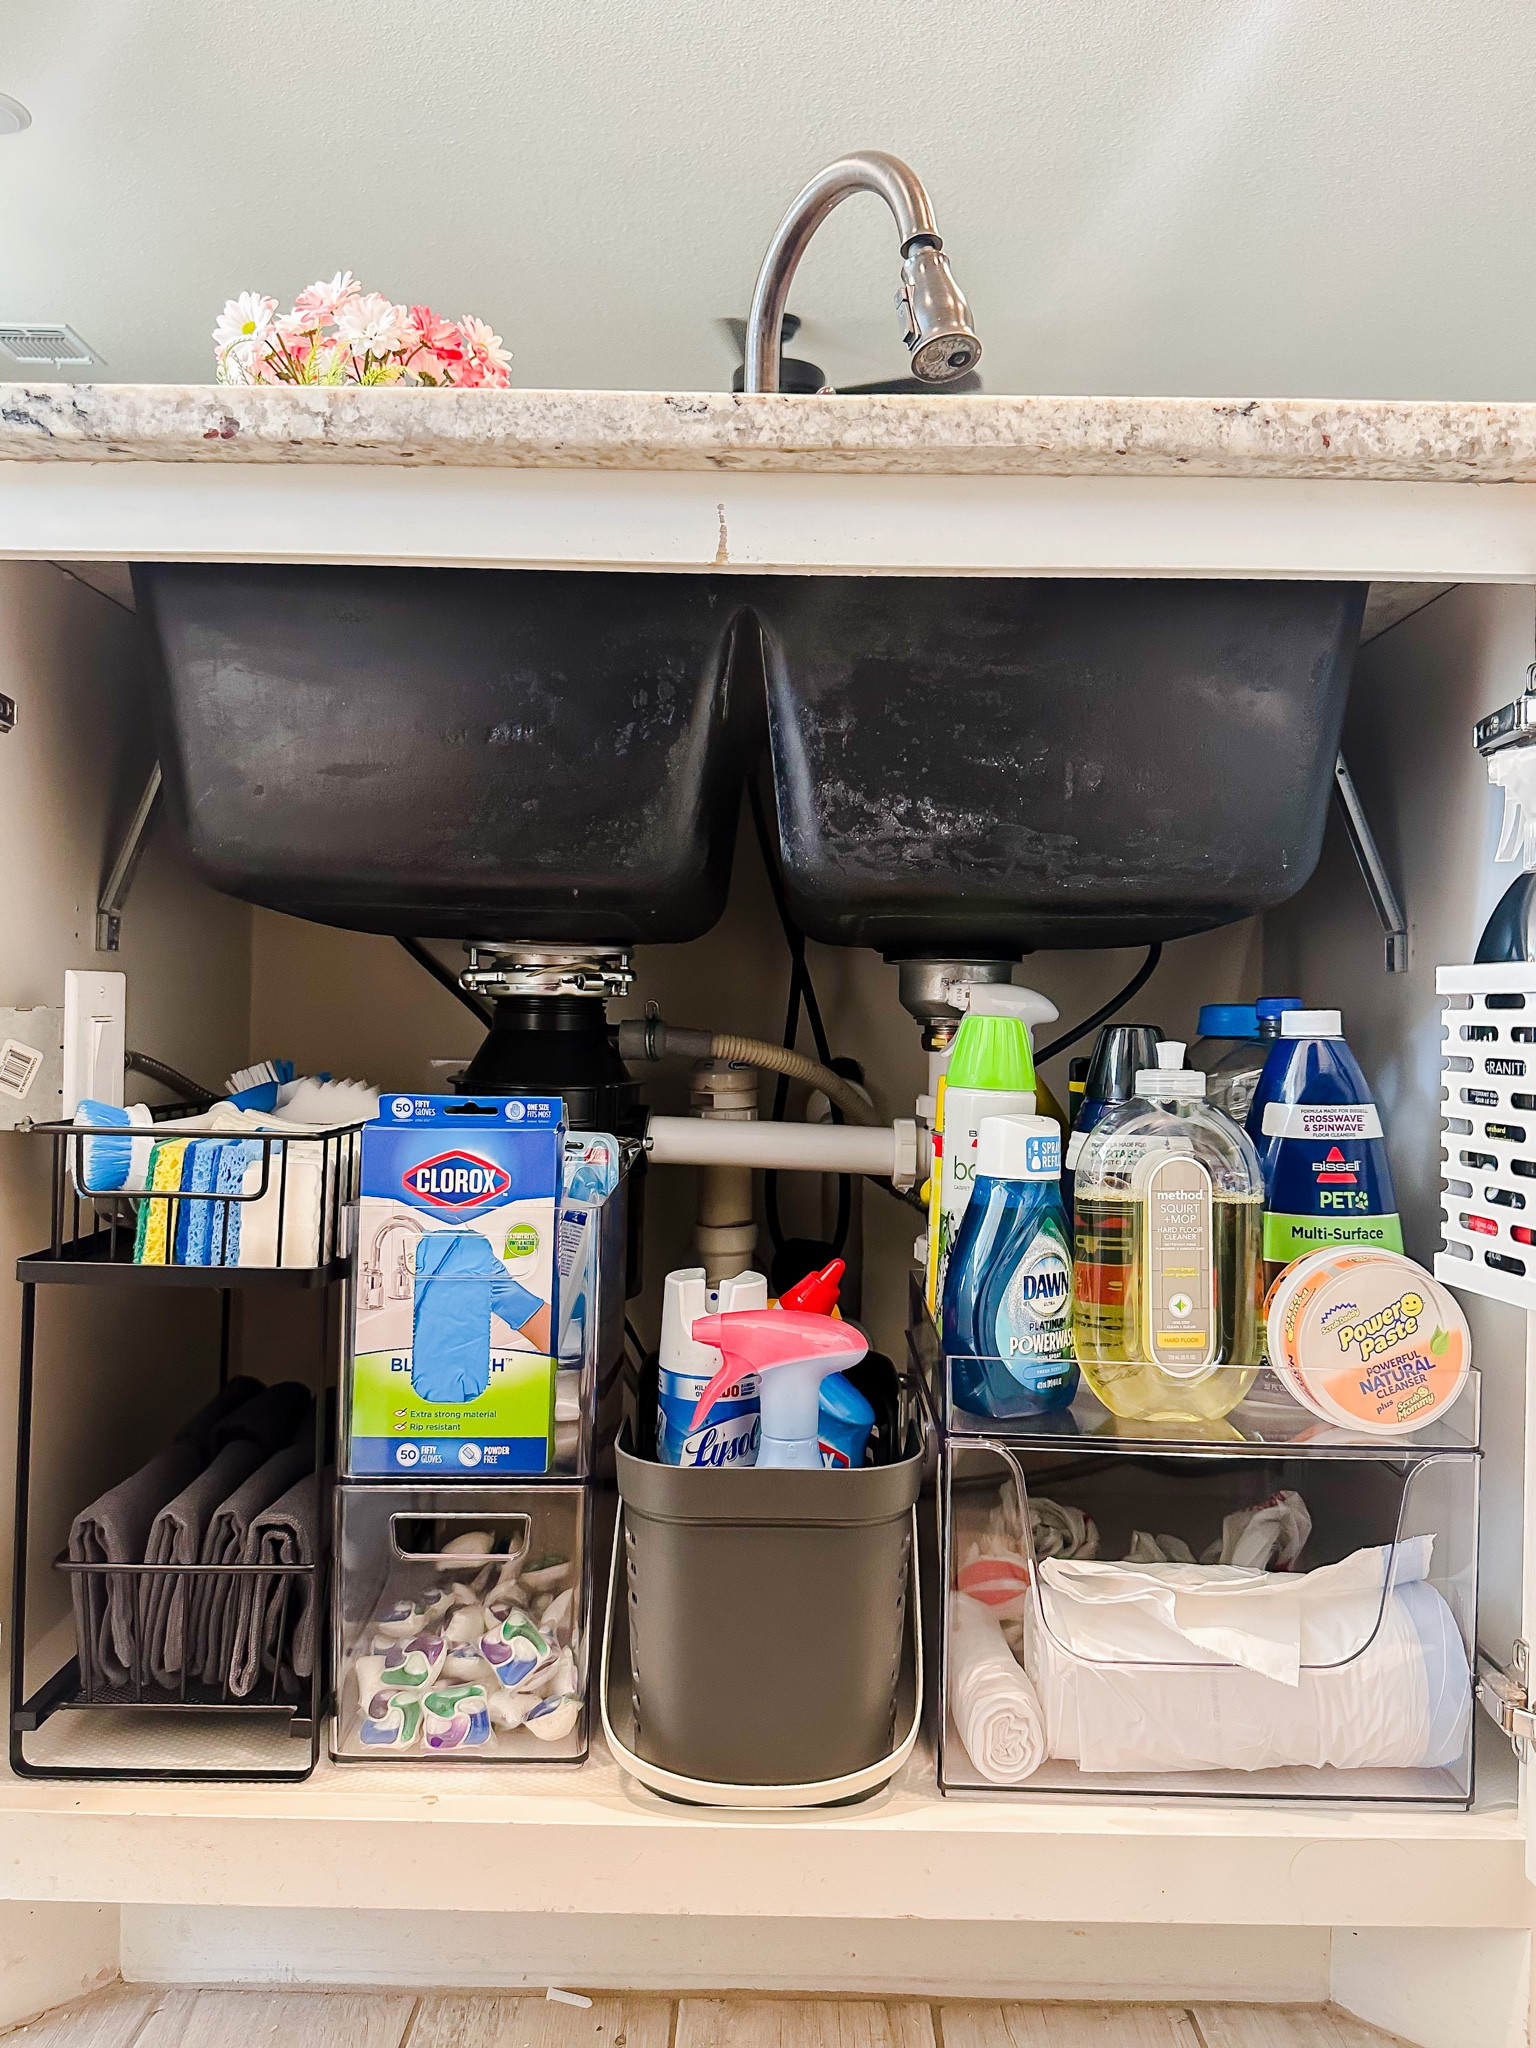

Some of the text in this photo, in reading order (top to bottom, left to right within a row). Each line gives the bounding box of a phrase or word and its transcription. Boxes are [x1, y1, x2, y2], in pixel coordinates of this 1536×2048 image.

[395, 1103, 411, 1112] 50
[415, 1100, 430, 1108] FIFTY
[527, 1103, 550, 1111] ONE SIZE
[415, 1108, 436, 1116] GLOVES
[527, 1110, 551, 1118] FITS MOST
[1304, 1124, 1310, 1132] &
[1041, 1141, 1060, 1154] SPRA
[416, 1168, 496, 1194] CLOROX
[1157, 1189, 1203, 1200] method
[1320, 1191, 1356, 1209] PET
[1160, 1204, 1200, 1213] SQUIRT
[1164, 1214, 1197, 1224] +MOP
[1291, 1226, 1383, 1240] Multi-Surface
[1023, 1270, 1069, 1300] DAWN
[1029, 1317, 1066, 1332] PLATINUM
[1338, 1300, 1402, 1352] Power
[1359, 1317, 1418, 1362] Paste
[1366, 1350, 1421, 1378] POWERFUL
[1358, 1356, 1436, 1396] NATURAL
[1376, 1375, 1428, 1399] CLEANSER
[1376, 1399, 1394, 1414] plus
[1397, 1393, 1421, 1412] Scrub
[1397, 1394, 1435, 1422] Mommy
[434, 1411, 461, 1419] strong
[463, 1410, 497, 1418] material
[410, 1423, 423, 1431] Rip
[686, 1414, 761, 1467] Lysol
[400, 1450, 417, 1460] 50
[420, 1446, 437, 1455] FIFTY
[483, 1446, 510, 1455] POWDER
[420, 1454, 443, 1464] GLOVES
[483, 1455, 498, 1464] FREE
